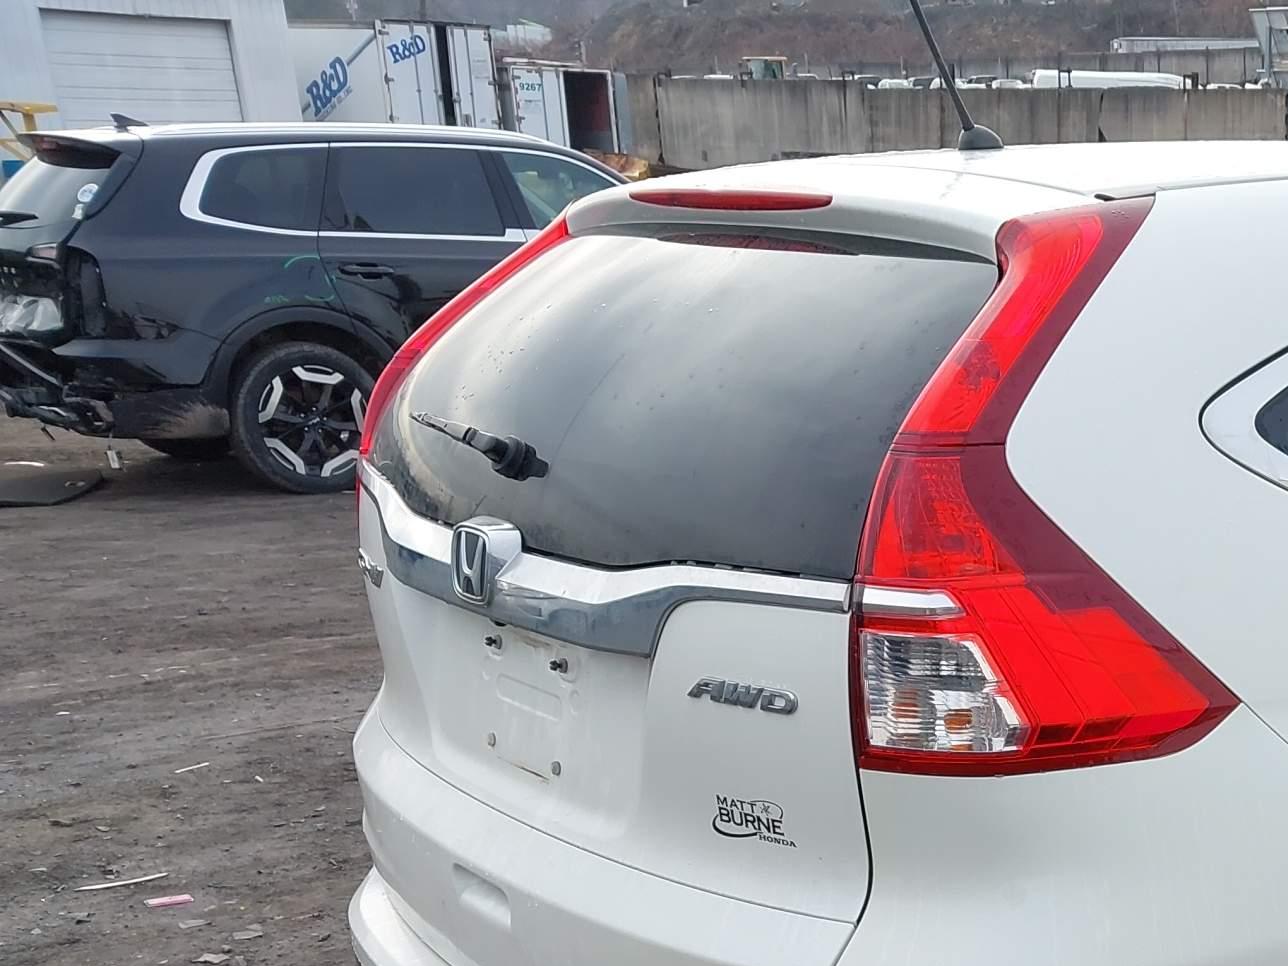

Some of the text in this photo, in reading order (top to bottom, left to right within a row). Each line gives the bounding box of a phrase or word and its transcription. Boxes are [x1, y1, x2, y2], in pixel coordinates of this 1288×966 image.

[387, 34, 425, 63] R&D
[306, 56, 348, 117] R&D
[687, 676, 798, 715] AWD
[715, 795, 757, 814] MATT
[718, 806, 785, 836] BURNE
[758, 833, 797, 848] HONDA
